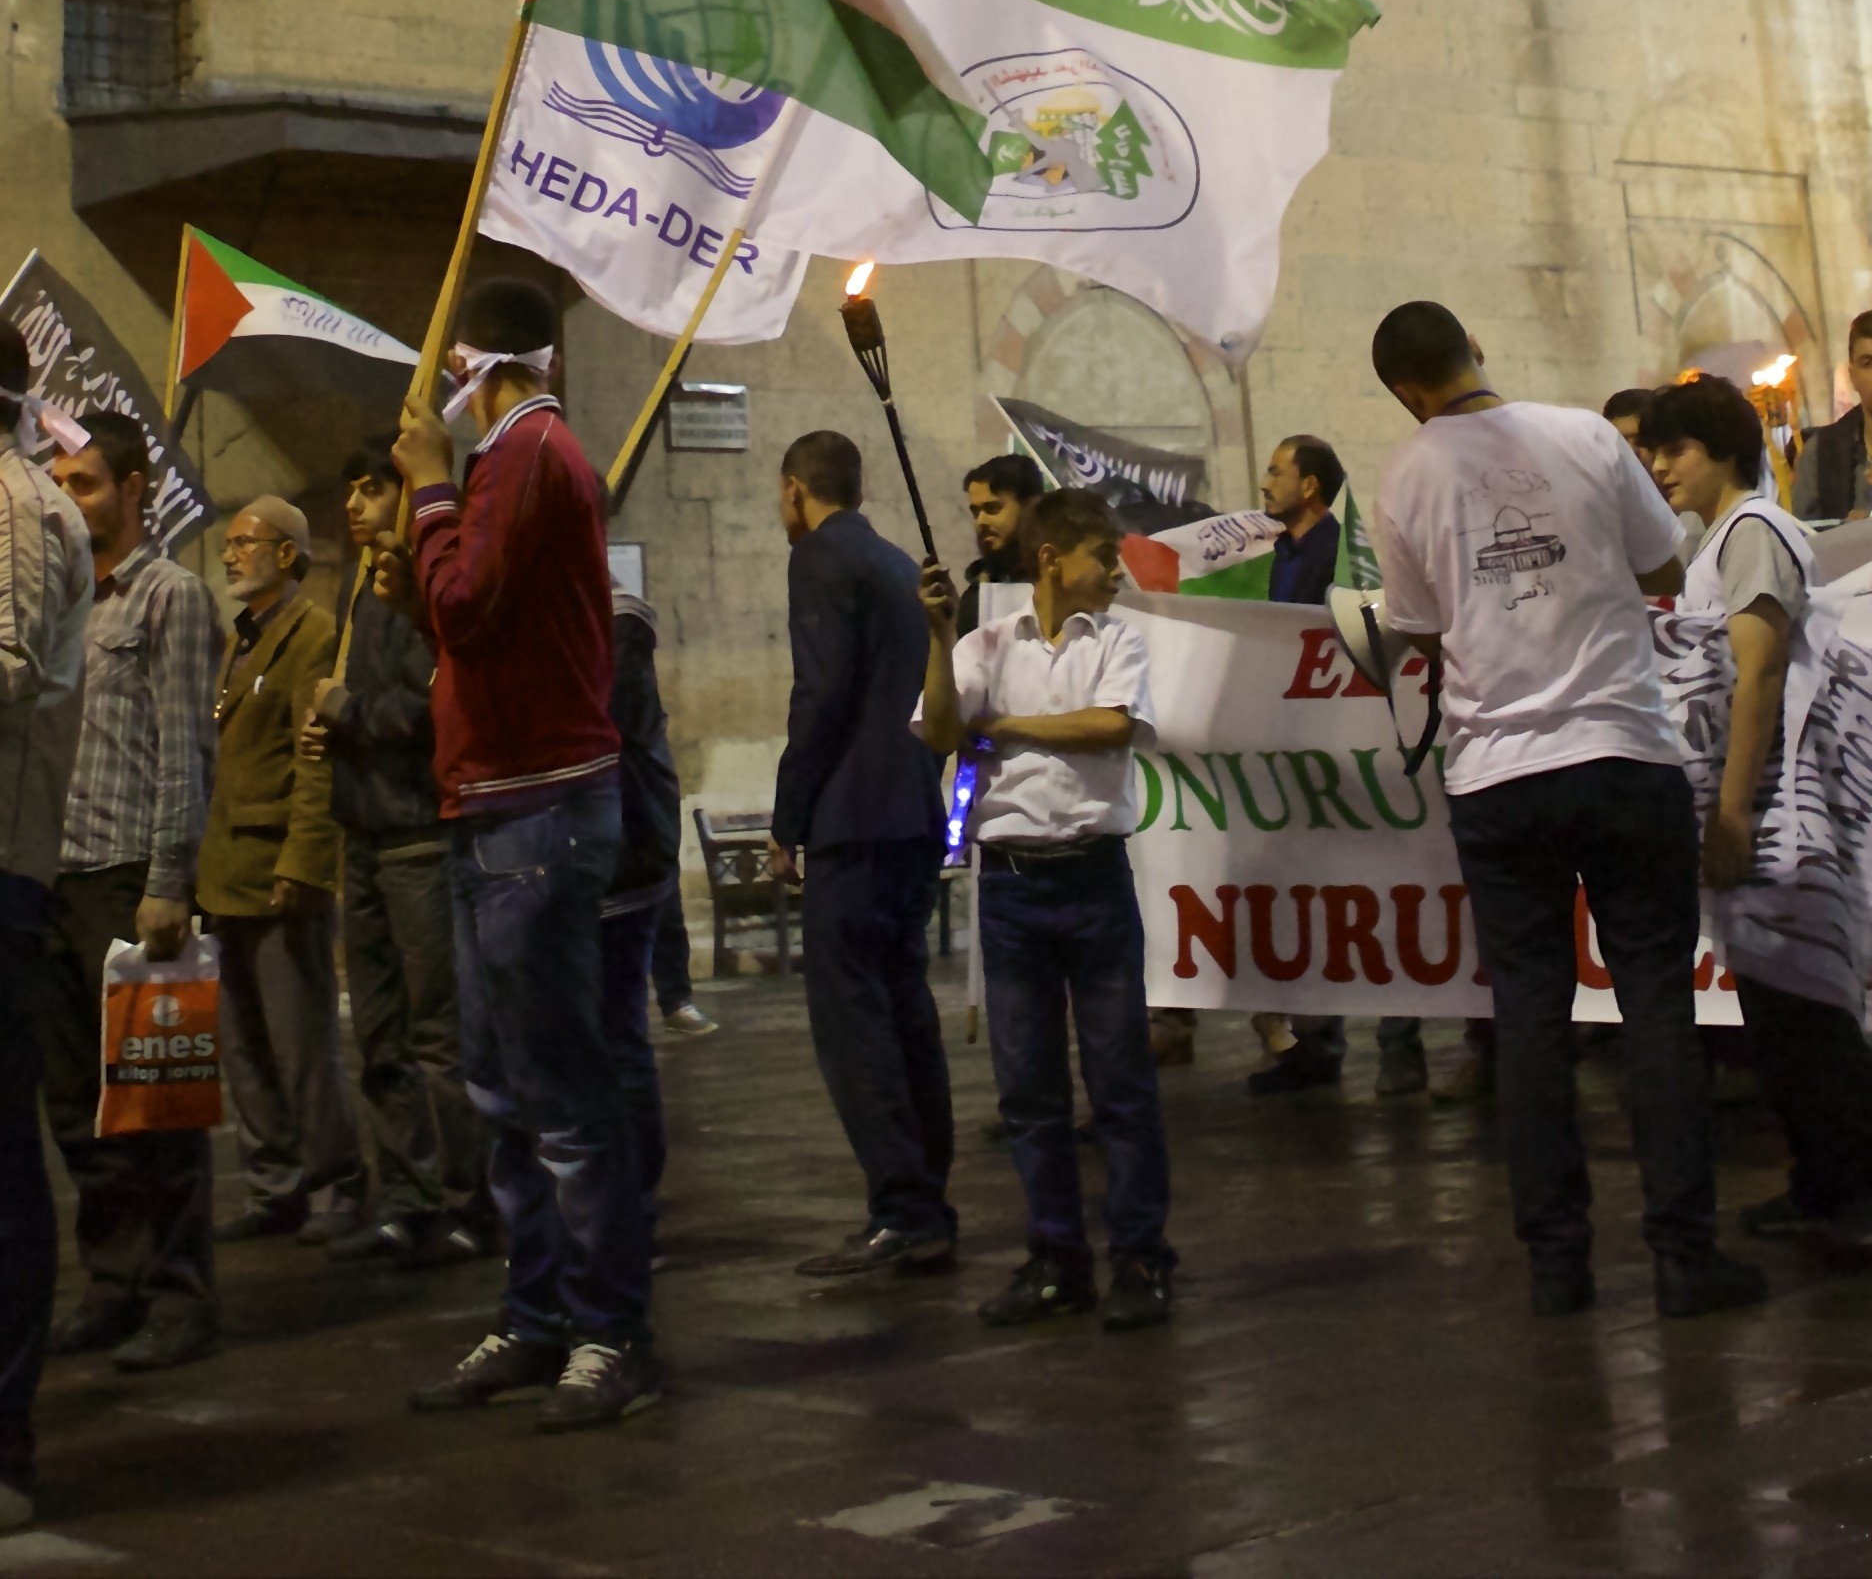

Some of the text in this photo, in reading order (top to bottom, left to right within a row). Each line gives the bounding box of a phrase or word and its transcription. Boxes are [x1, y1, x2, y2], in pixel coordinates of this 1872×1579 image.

[510, 140, 759, 275] HEDA-DER
[1134, 746, 1447, 832] NURU
[1169, 884, 1492, 986] NURU
[121, 1033, 215, 1060] enes
